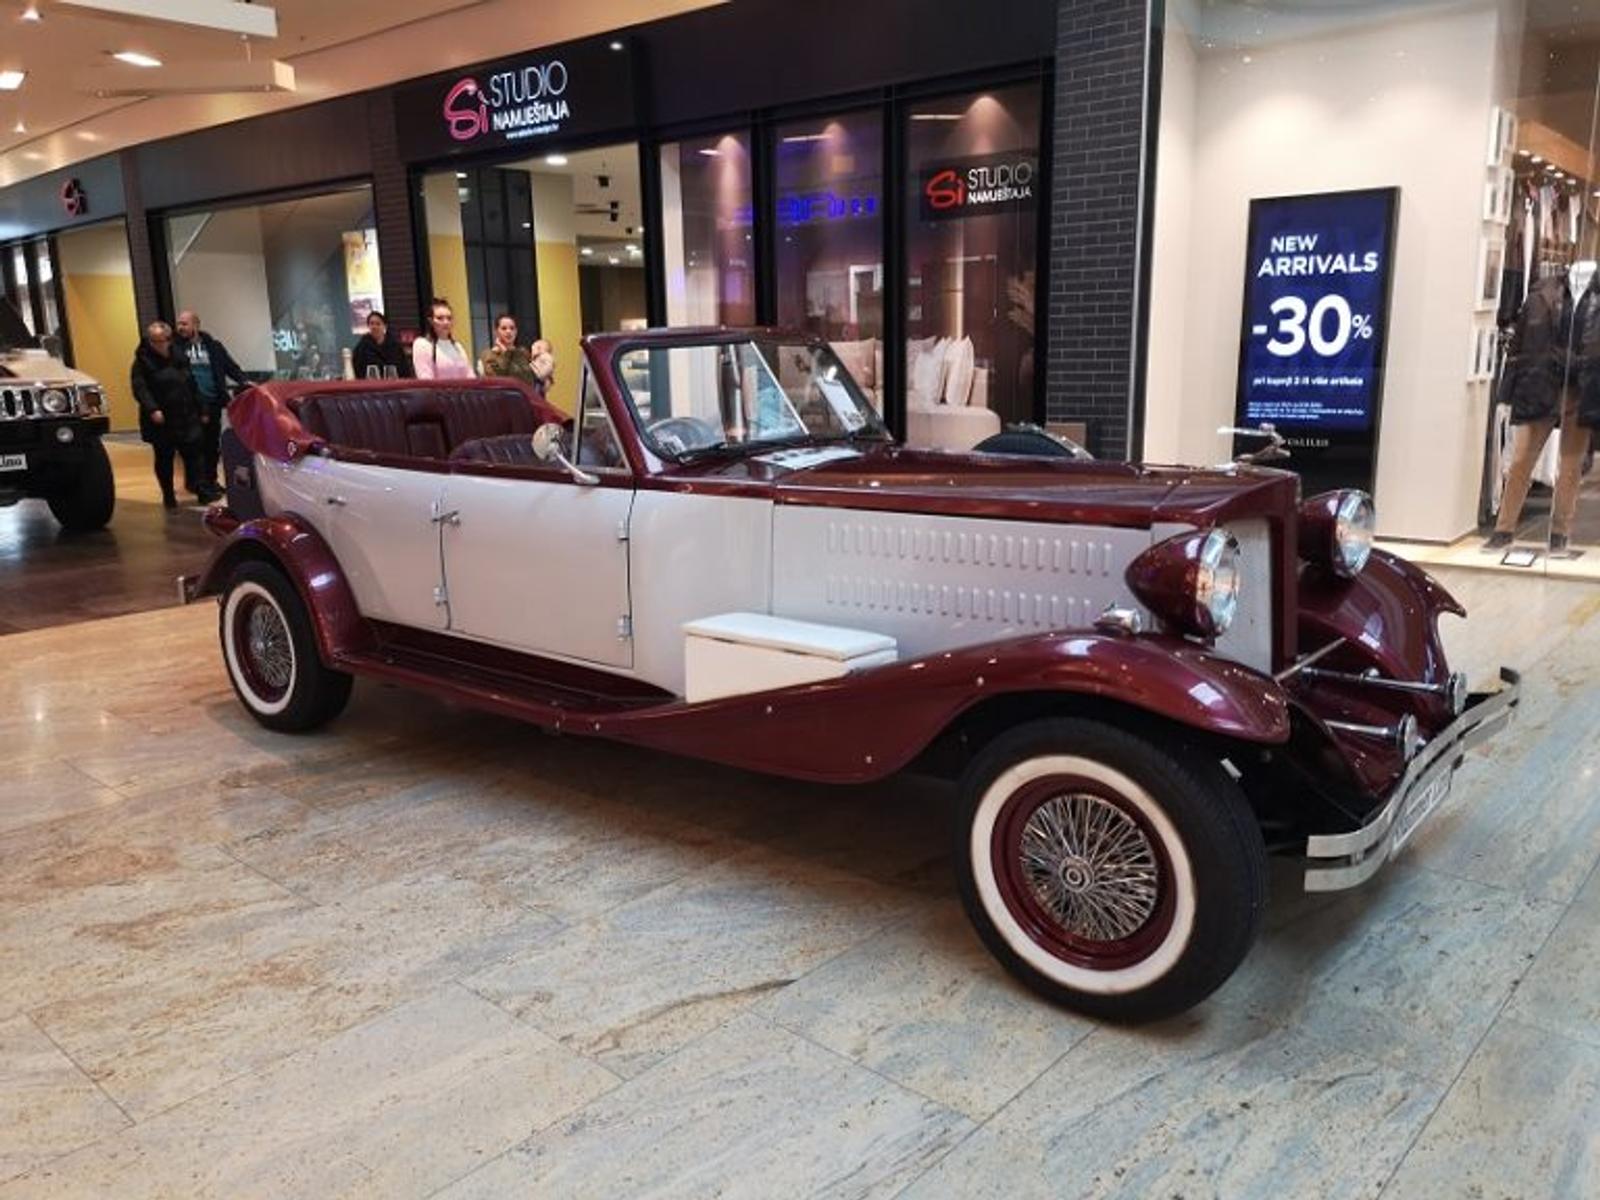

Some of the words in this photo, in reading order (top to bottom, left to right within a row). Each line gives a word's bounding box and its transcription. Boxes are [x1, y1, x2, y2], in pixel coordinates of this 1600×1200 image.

[490, 60, 568, 107] STUDIO
[493, 99, 570, 131] NAMJEŠTAJA
[967, 162, 1032, 190] STUDIO
[1270, 234, 1319, 253] NEW
[1257, 252, 1379, 277] ARRIVALS
[1252, 294, 1373, 357] -30%
